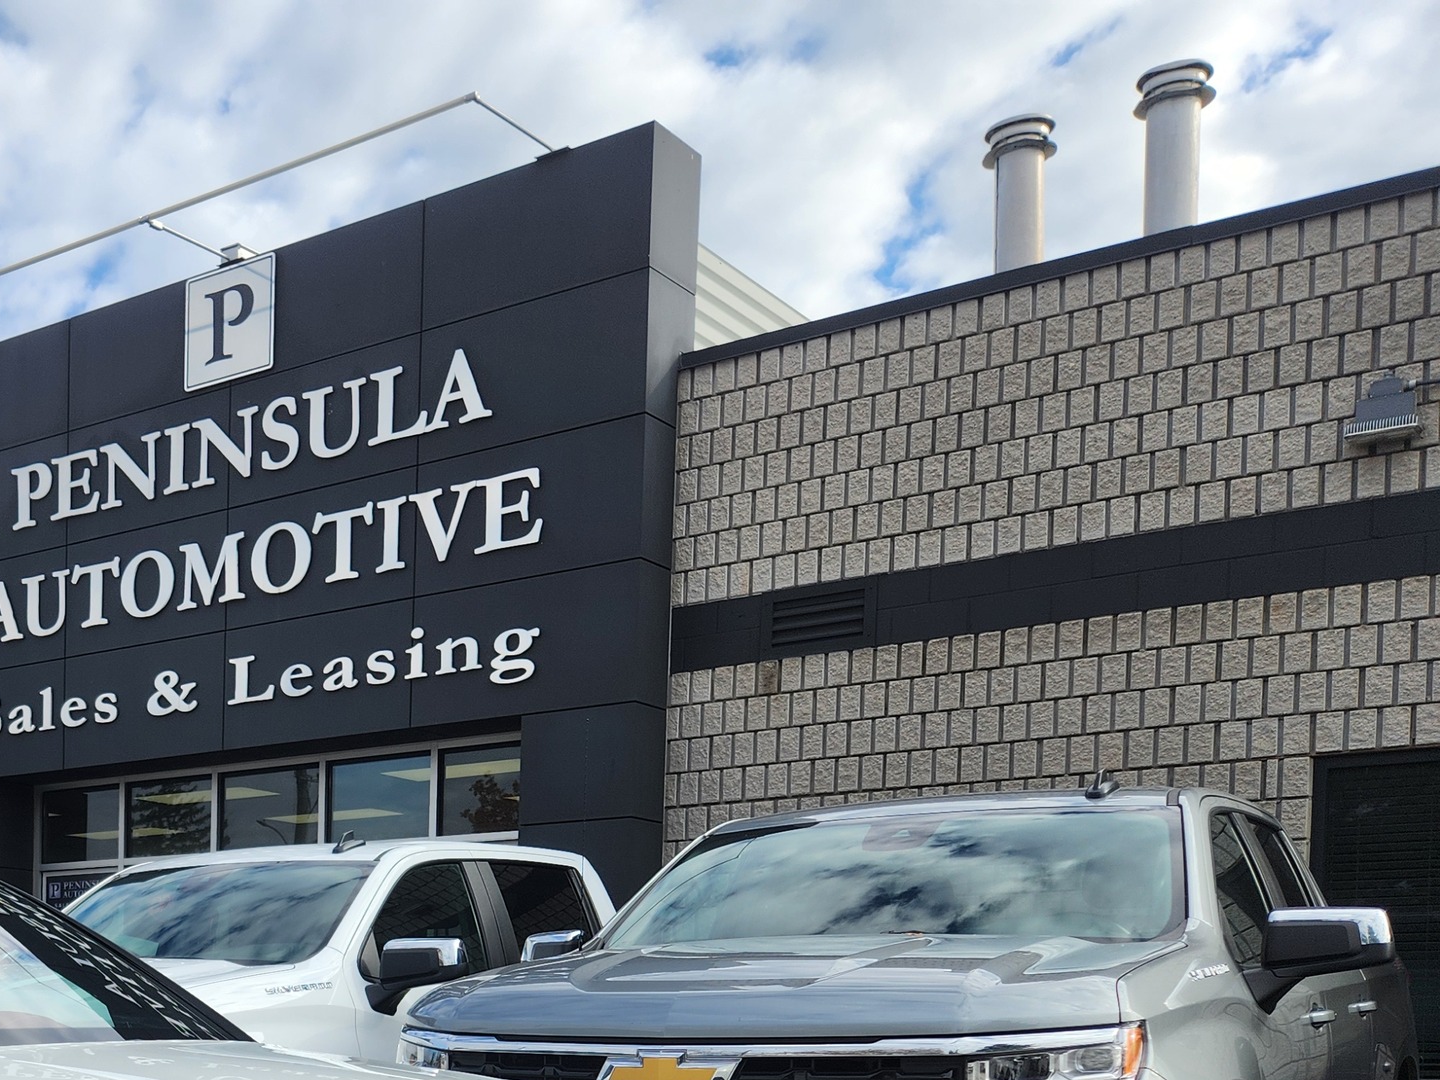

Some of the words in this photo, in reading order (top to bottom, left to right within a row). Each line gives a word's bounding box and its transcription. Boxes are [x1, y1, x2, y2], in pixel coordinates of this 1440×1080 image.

[205, 283, 254, 366] P
[11, 348, 492, 531] PENINSULA
[147, 669, 198, 717] &
[228, 626, 540, 706] Leasing
[63, 889, 88, 899] AUTO
